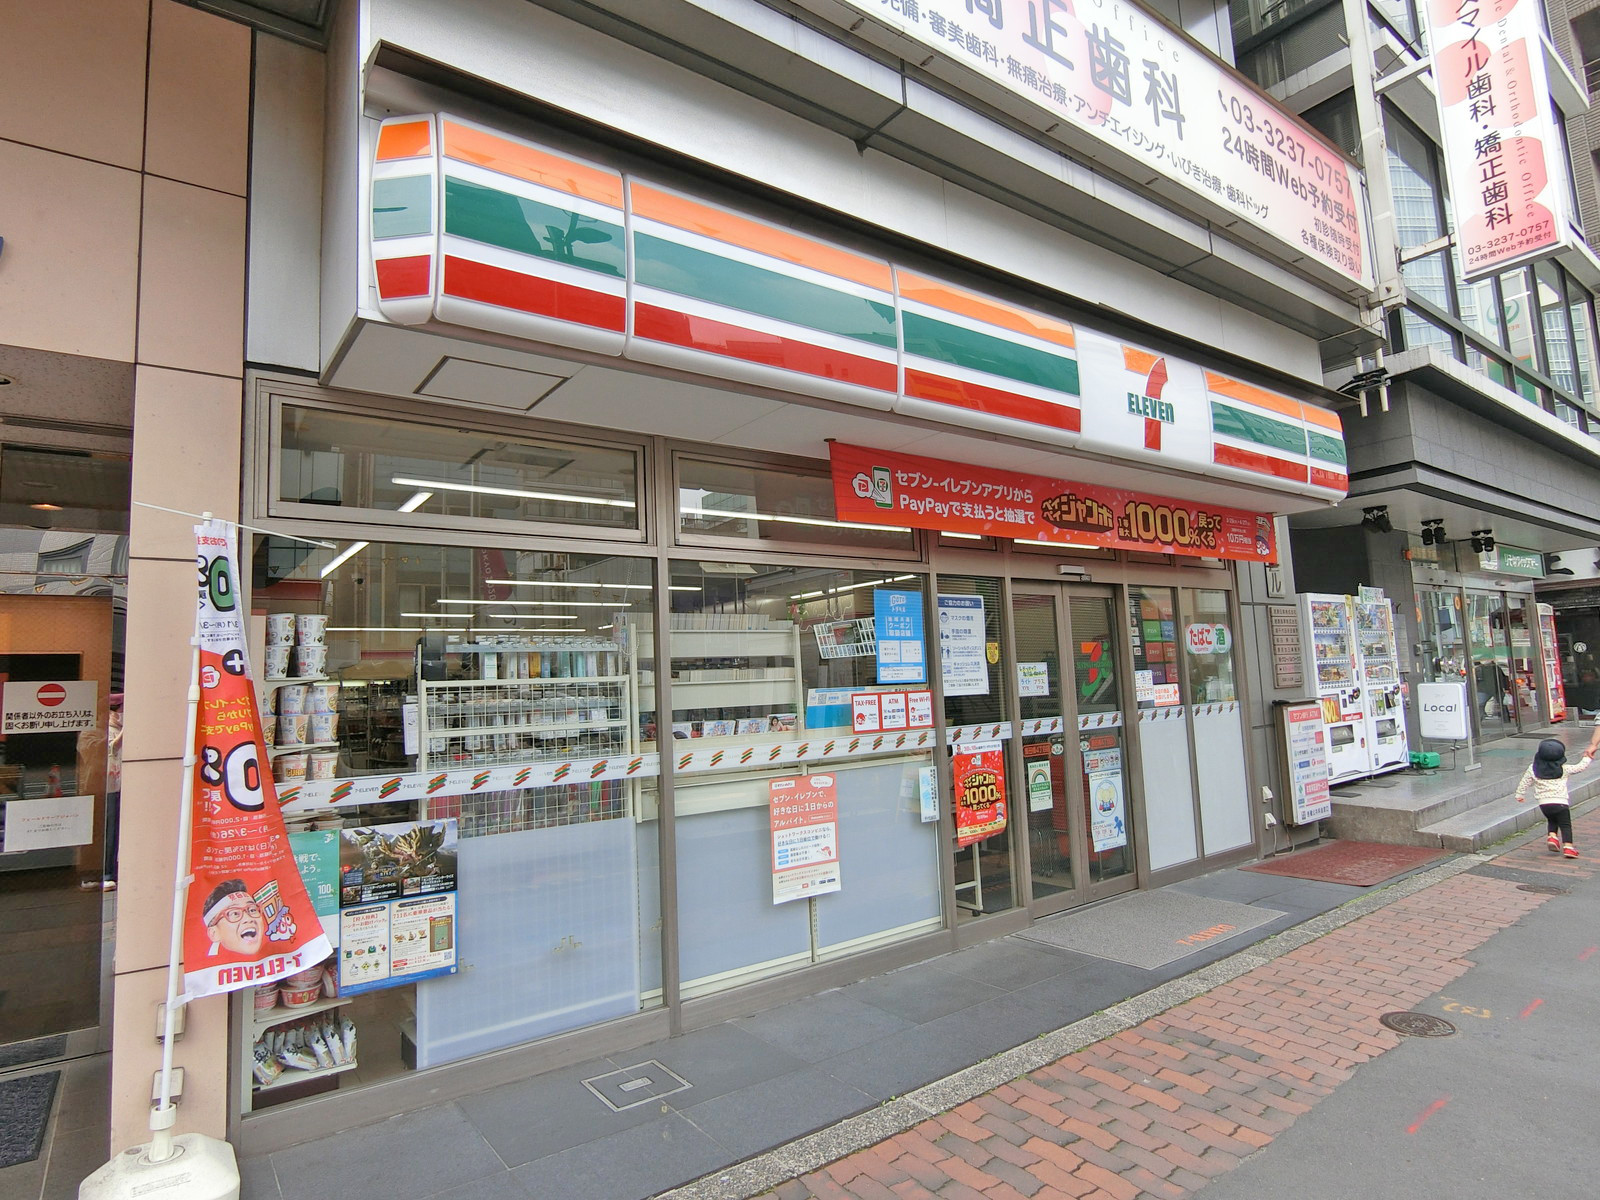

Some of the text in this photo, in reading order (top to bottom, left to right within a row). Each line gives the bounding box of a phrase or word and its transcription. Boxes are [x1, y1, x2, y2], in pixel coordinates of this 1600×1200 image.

[1467, 219, 1550, 256] 03-3237-0757
[1189, 628, 1213, 646] たばこ
[1214, 628, 1226, 646] 酒
[1423, 703, 1457, 713] Local
[5, 720, 94, 731] 固くお断り申し上げます。
